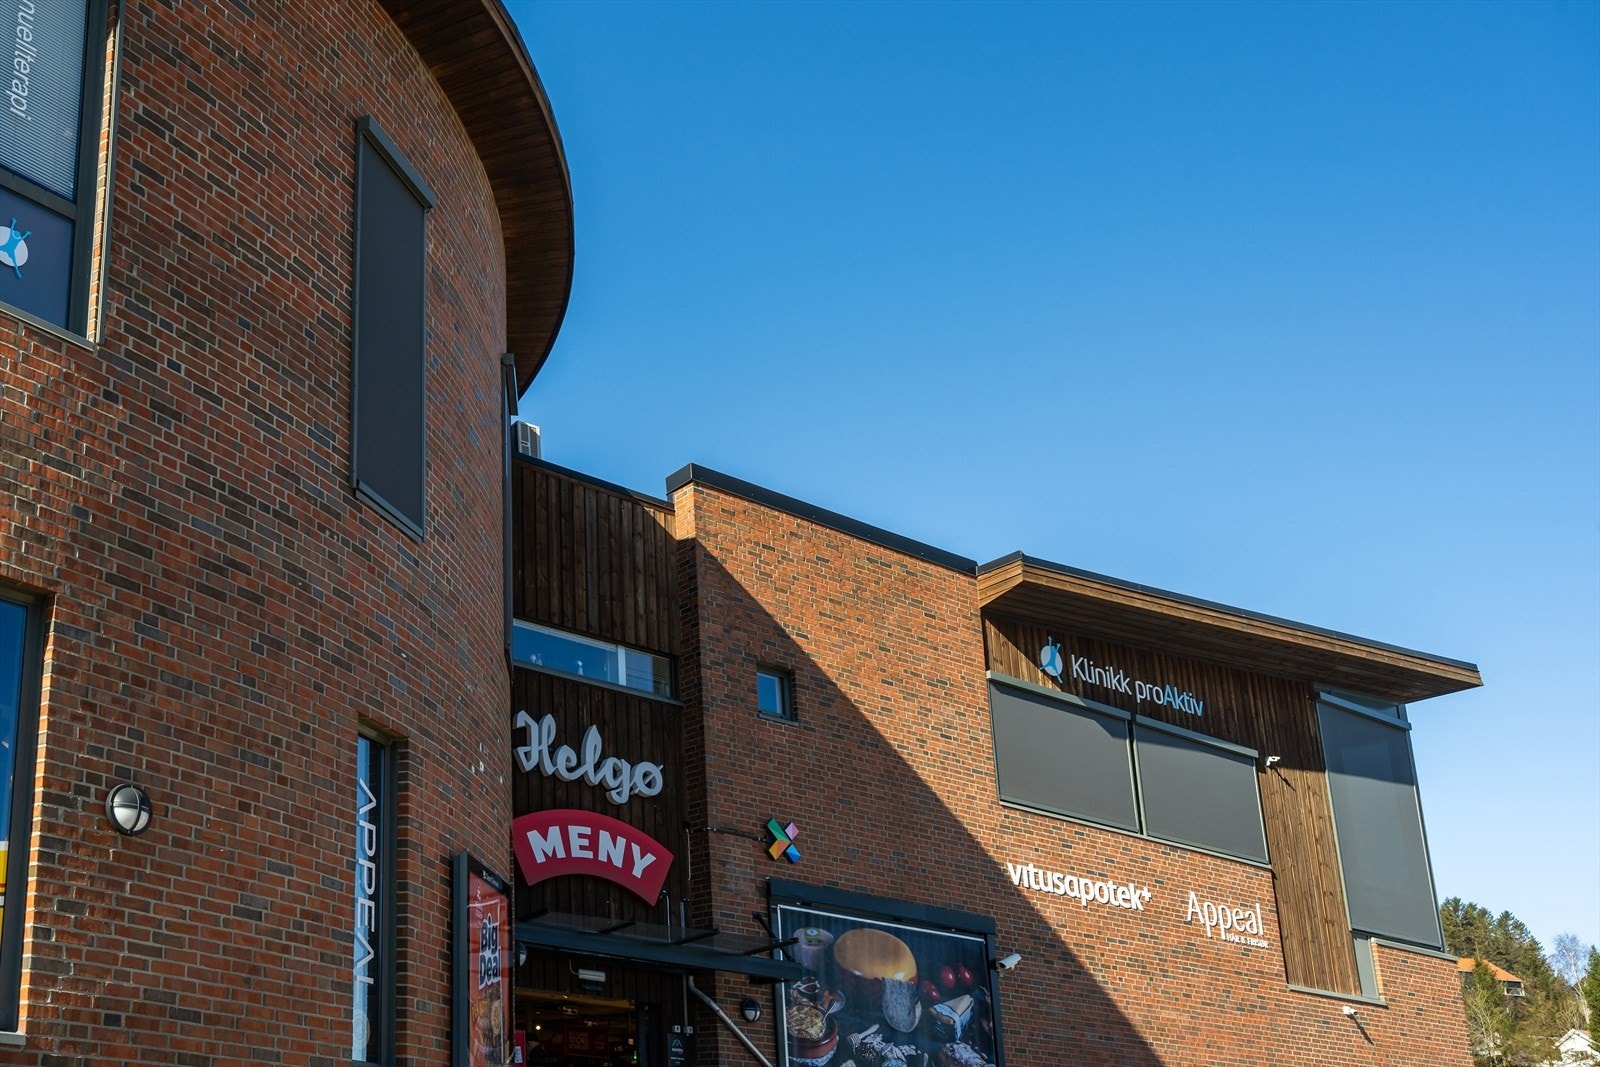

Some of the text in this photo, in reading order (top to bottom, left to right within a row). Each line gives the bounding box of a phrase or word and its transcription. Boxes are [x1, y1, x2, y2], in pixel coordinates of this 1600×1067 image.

[1071, 654, 1203, 717] Klinikk proAktiv
[513, 709, 664, 806] Helgø
[526, 825, 657, 879] MENY
[356, 777, 377, 1005] APPEAL
[1187, 891, 1264, 941] Appeal
[480, 913, 499, 956] Big
[479, 953, 502, 989] Deal
